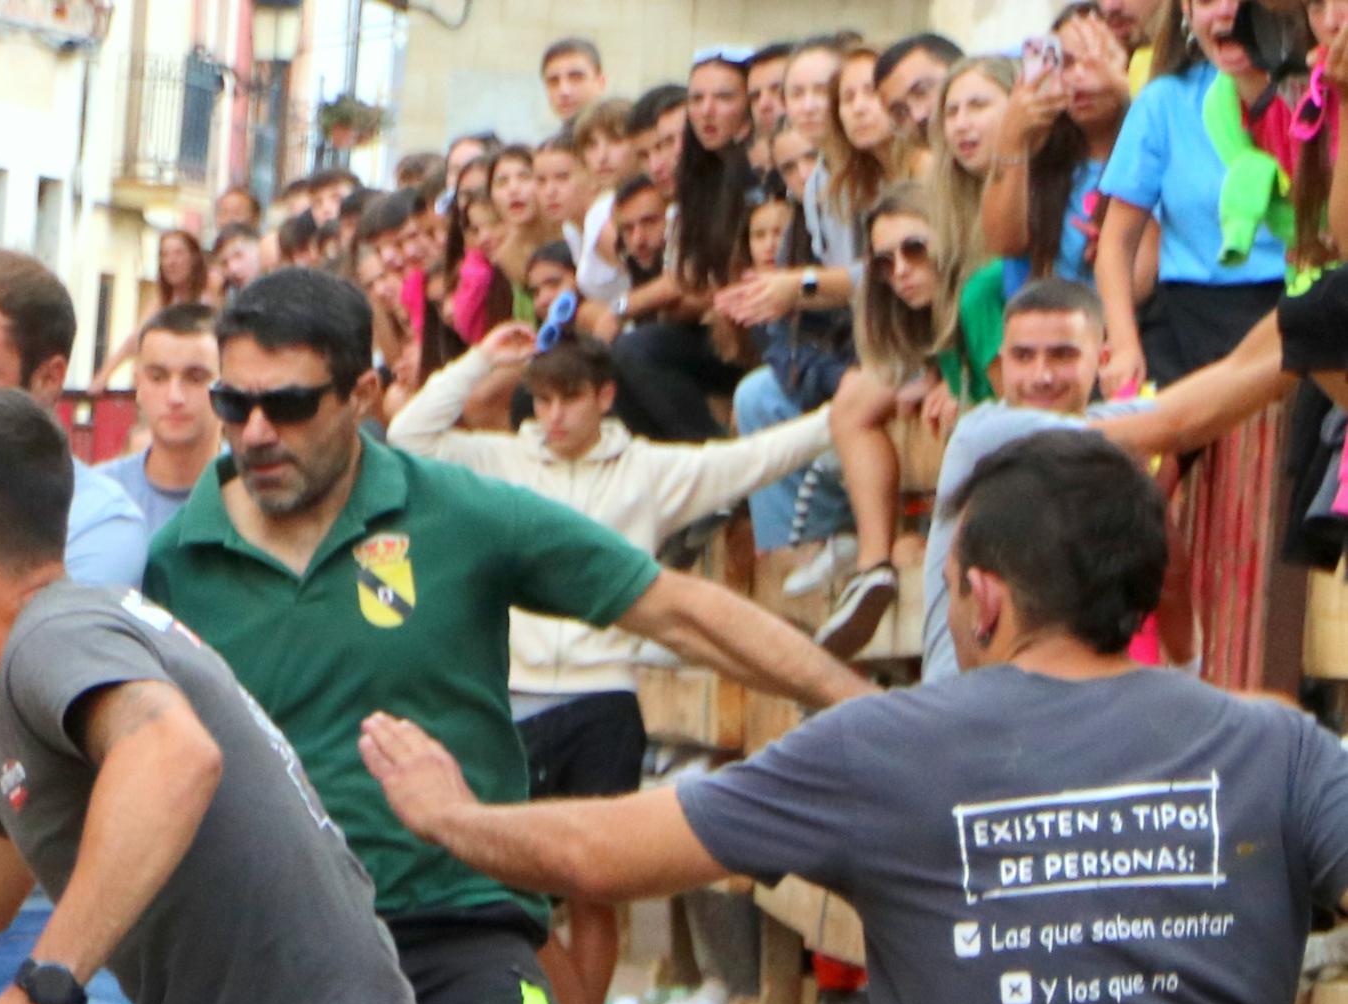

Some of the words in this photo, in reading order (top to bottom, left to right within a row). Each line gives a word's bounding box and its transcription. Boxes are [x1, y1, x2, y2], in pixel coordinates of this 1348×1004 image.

[973, 810, 1099, 847] EXISTEN
[1110, 811, 1123, 834] 3
[1132, 803, 1209, 831] TIPOS
[1000, 856, 1034, 886] DE
[1044, 845, 1195, 881] PERSONAS:
[991, 923, 1032, 952] Las
[1040, 921, 1083, 953] que
[1091, 913, 1156, 942] saben
[1162, 912, 1234, 939] contar
[1067, 975, 1101, 1004] los
[1108, 973, 1145, 1004] que
[1152, 972, 1179, 993] no
